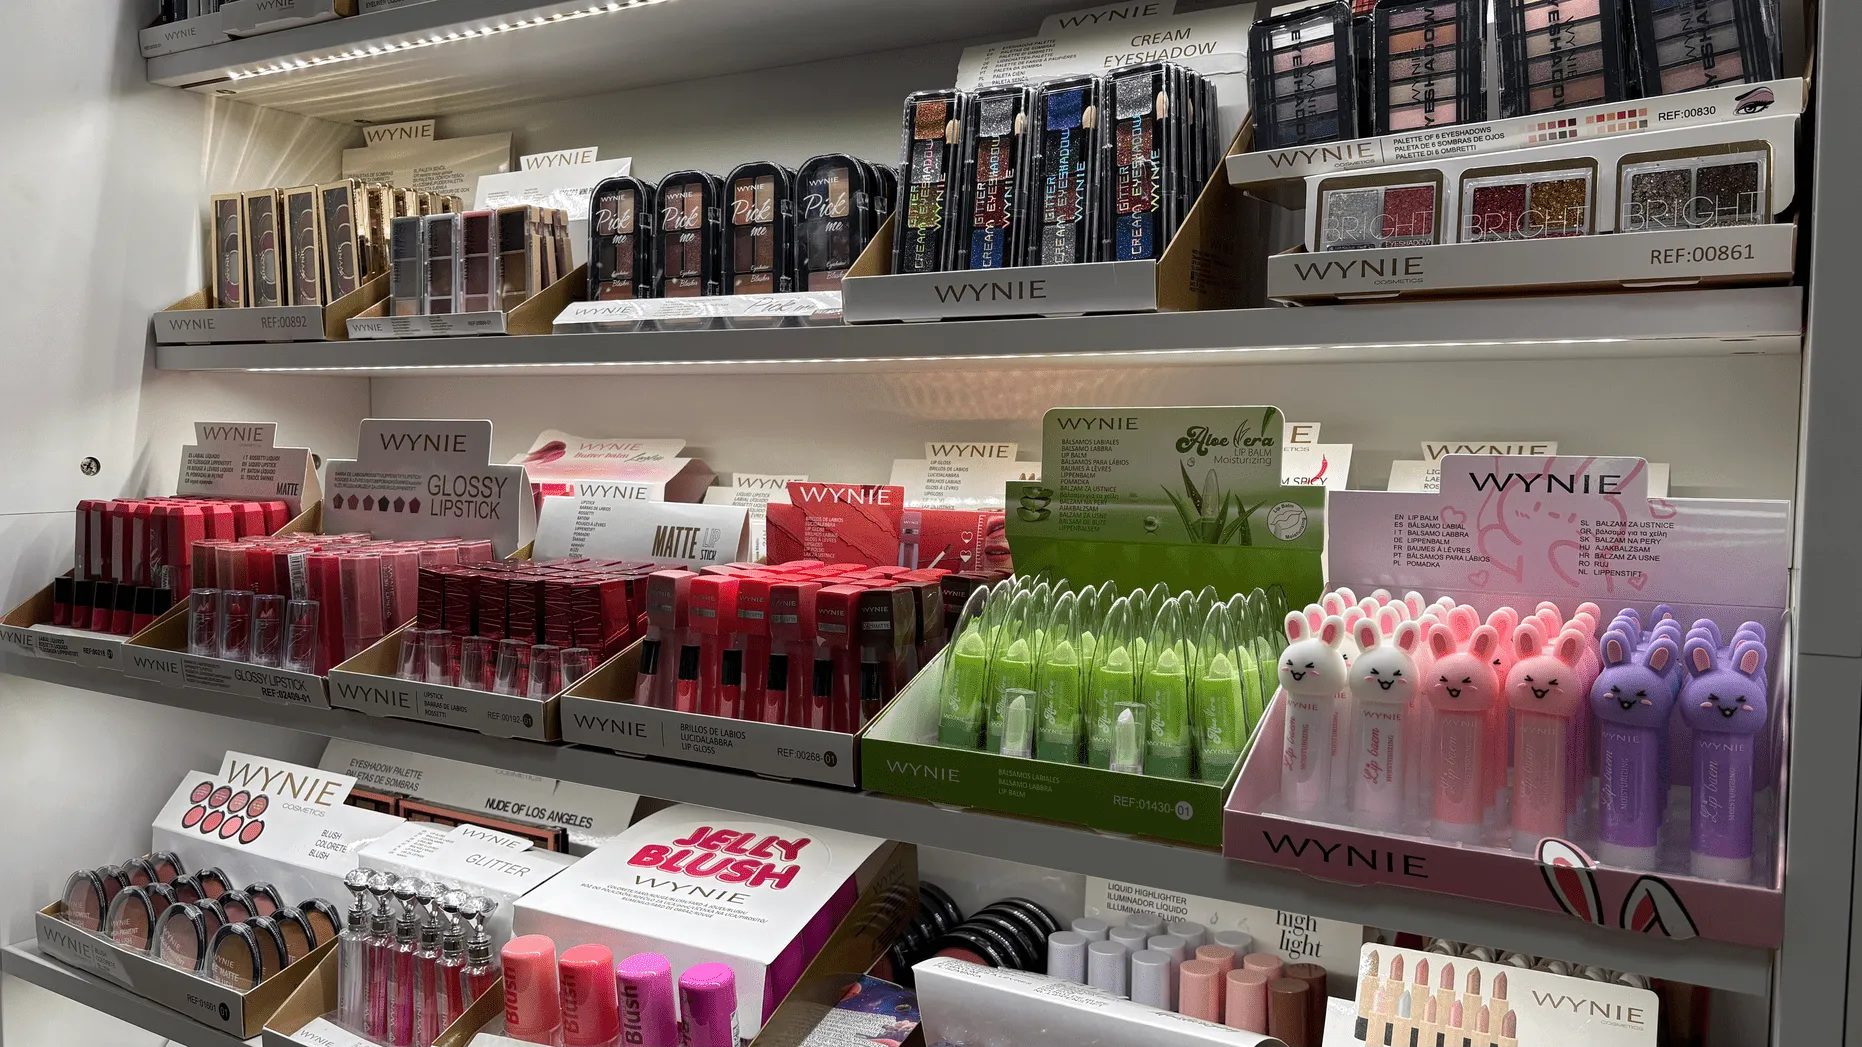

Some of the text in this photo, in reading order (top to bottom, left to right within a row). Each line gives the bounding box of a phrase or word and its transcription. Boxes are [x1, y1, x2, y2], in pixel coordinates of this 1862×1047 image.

[1059, 3, 1159, 28] WYNIE
[164, 27, 196, 41] WYNIE
[1131, 28, 1191, 47] CREAM
[1104, 42, 1217, 68] EYESHADOW
[1658, 105, 1716, 122] REF:00830
[367, 124, 431, 142] WYNIE
[1394, 126, 1492, 145] PALETTE EYESHADOWS
[1394, 133, 1505, 152] PALETA SOMBRAS OJOS
[526, 150, 592, 170] WYNIE
[1268, 142, 1374, 169] WYNIE
[1396, 145, 1476, 160] PALETTE OMBRETTI
[736, 184, 764, 192] WYNIE
[809, 176, 839, 186] WYNIE
[1151, 148, 1160, 212] WYNIE
[601, 194, 626, 202] WYNIE
[667, 191, 693, 200] WYNIE
[1002, 168, 1014, 228] WYNIE
[1074, 161, 1086, 222] WYNIE
[731, 200, 772, 224] Pick
[804, 192, 847, 218] Pick
[934, 172, 946, 232] WYNIE
[1622, 190, 1764, 231] BRIGHT
[596, 209, 631, 232] Pick
[662, 206, 700, 230] Pick
[1322, 210, 1434, 243] BRIGHT
[1464, 206, 1589, 242] BRIGHT
[1649, 244, 1754, 266] REF:00861
[1294, 256, 1424, 280] WYNIE
[934, 280, 1047, 303] WYNIE
[1374, 278, 1424, 286] COSMETICS
[169, 318, 215, 330] WYNIE
[261, 316, 308, 328] REF:00892
[352, 323, 383, 332] WYNIE
[204, 426, 263, 442] WYNIE
[1058, 418, 1138, 430] WYNIE
[380, 434, 466, 452] WYNIE
[932, 444, 1010, 458] WYNIE
[1176, 426, 1230, 456] Aloe
[1214, 456, 1272, 466] Moisturizing
[1234, 448, 1272, 456] LIP BALM
[276, 482, 299, 496] MATTE
[428, 474, 508, 498] GLOSSY
[580, 484, 648, 500] WYNIE
[1469, 472, 1622, 494] WYNIE
[800, 486, 892, 506] WYNIE
[430, 500, 500, 520] LIPSTICK
[652, 526, 720, 560] MATTE LIP
[700, 550, 716, 560] STICK
[1465, 554, 1490, 562] LÁBIOS
[818, 608, 844, 617] WYNIE
[134, 656, 179, 674] WYNIE
[234, 669, 268, 684] GLOSSY
[268, 675, 307, 692] LIPSTICK
[261, 687, 312, 703] REF:02409-01
[337, 682, 410, 708] WYNIE
[424, 692, 444, 700] LIPSTICK
[424, 700, 468, 714] BARRAS LABIOS
[424, 710, 446, 719] ROSSETTI
[1364, 710, 1402, 722] WYNIE
[574, 713, 647, 738] WYNIE
[680, 722, 746, 740] BRILLOS DE LABIOS
[680, 732, 733, 748] LUCIDALABBRA
[682, 742, 716, 755] LIP GLOSS
[1700, 742, 1744, 752] WYNIE
[1386, 735, 1394, 782] MOISTURIZING
[350, 758, 424, 780] EYESHADOW PALETTE
[886, 760, 960, 783] WYNIE
[228, 760, 342, 807] WYNIE
[384, 777, 420, 792] SOMBRAS
[282, 802, 326, 818] COSMETICS
[485, 798, 594, 829] NUDE OF LOS ANGELES
[321, 829, 342, 840] BLUSH
[462, 828, 522, 850] WYNIE
[672, 826, 812, 862] JELLY
[308, 849, 330, 860] BLUSH
[315, 840, 348, 854] COLORETE
[1262, 831, 1430, 880] WYNIE
[466, 854, 532, 878] GLITTER
[627, 844, 801, 890] BLUSH
[635, 875, 750, 904] WYNIE
[1108, 883, 1187, 905] LIQUID HIGHLIGHTER
[1107, 892, 1188, 916] ILUMINADOR LÍQUIDO
[1276, 910, 1318, 936] high
[44, 926, 92, 959] WYNIE
[1280, 929, 1322, 960] light
[504, 966, 520, 1025] Blush
[563, 972, 580, 1034] Blush
[625, 984, 644, 1046] Blush
[1532, 990, 1645, 1026] WYNIE
[1600, 1019, 1644, 1032] COSMETICS
